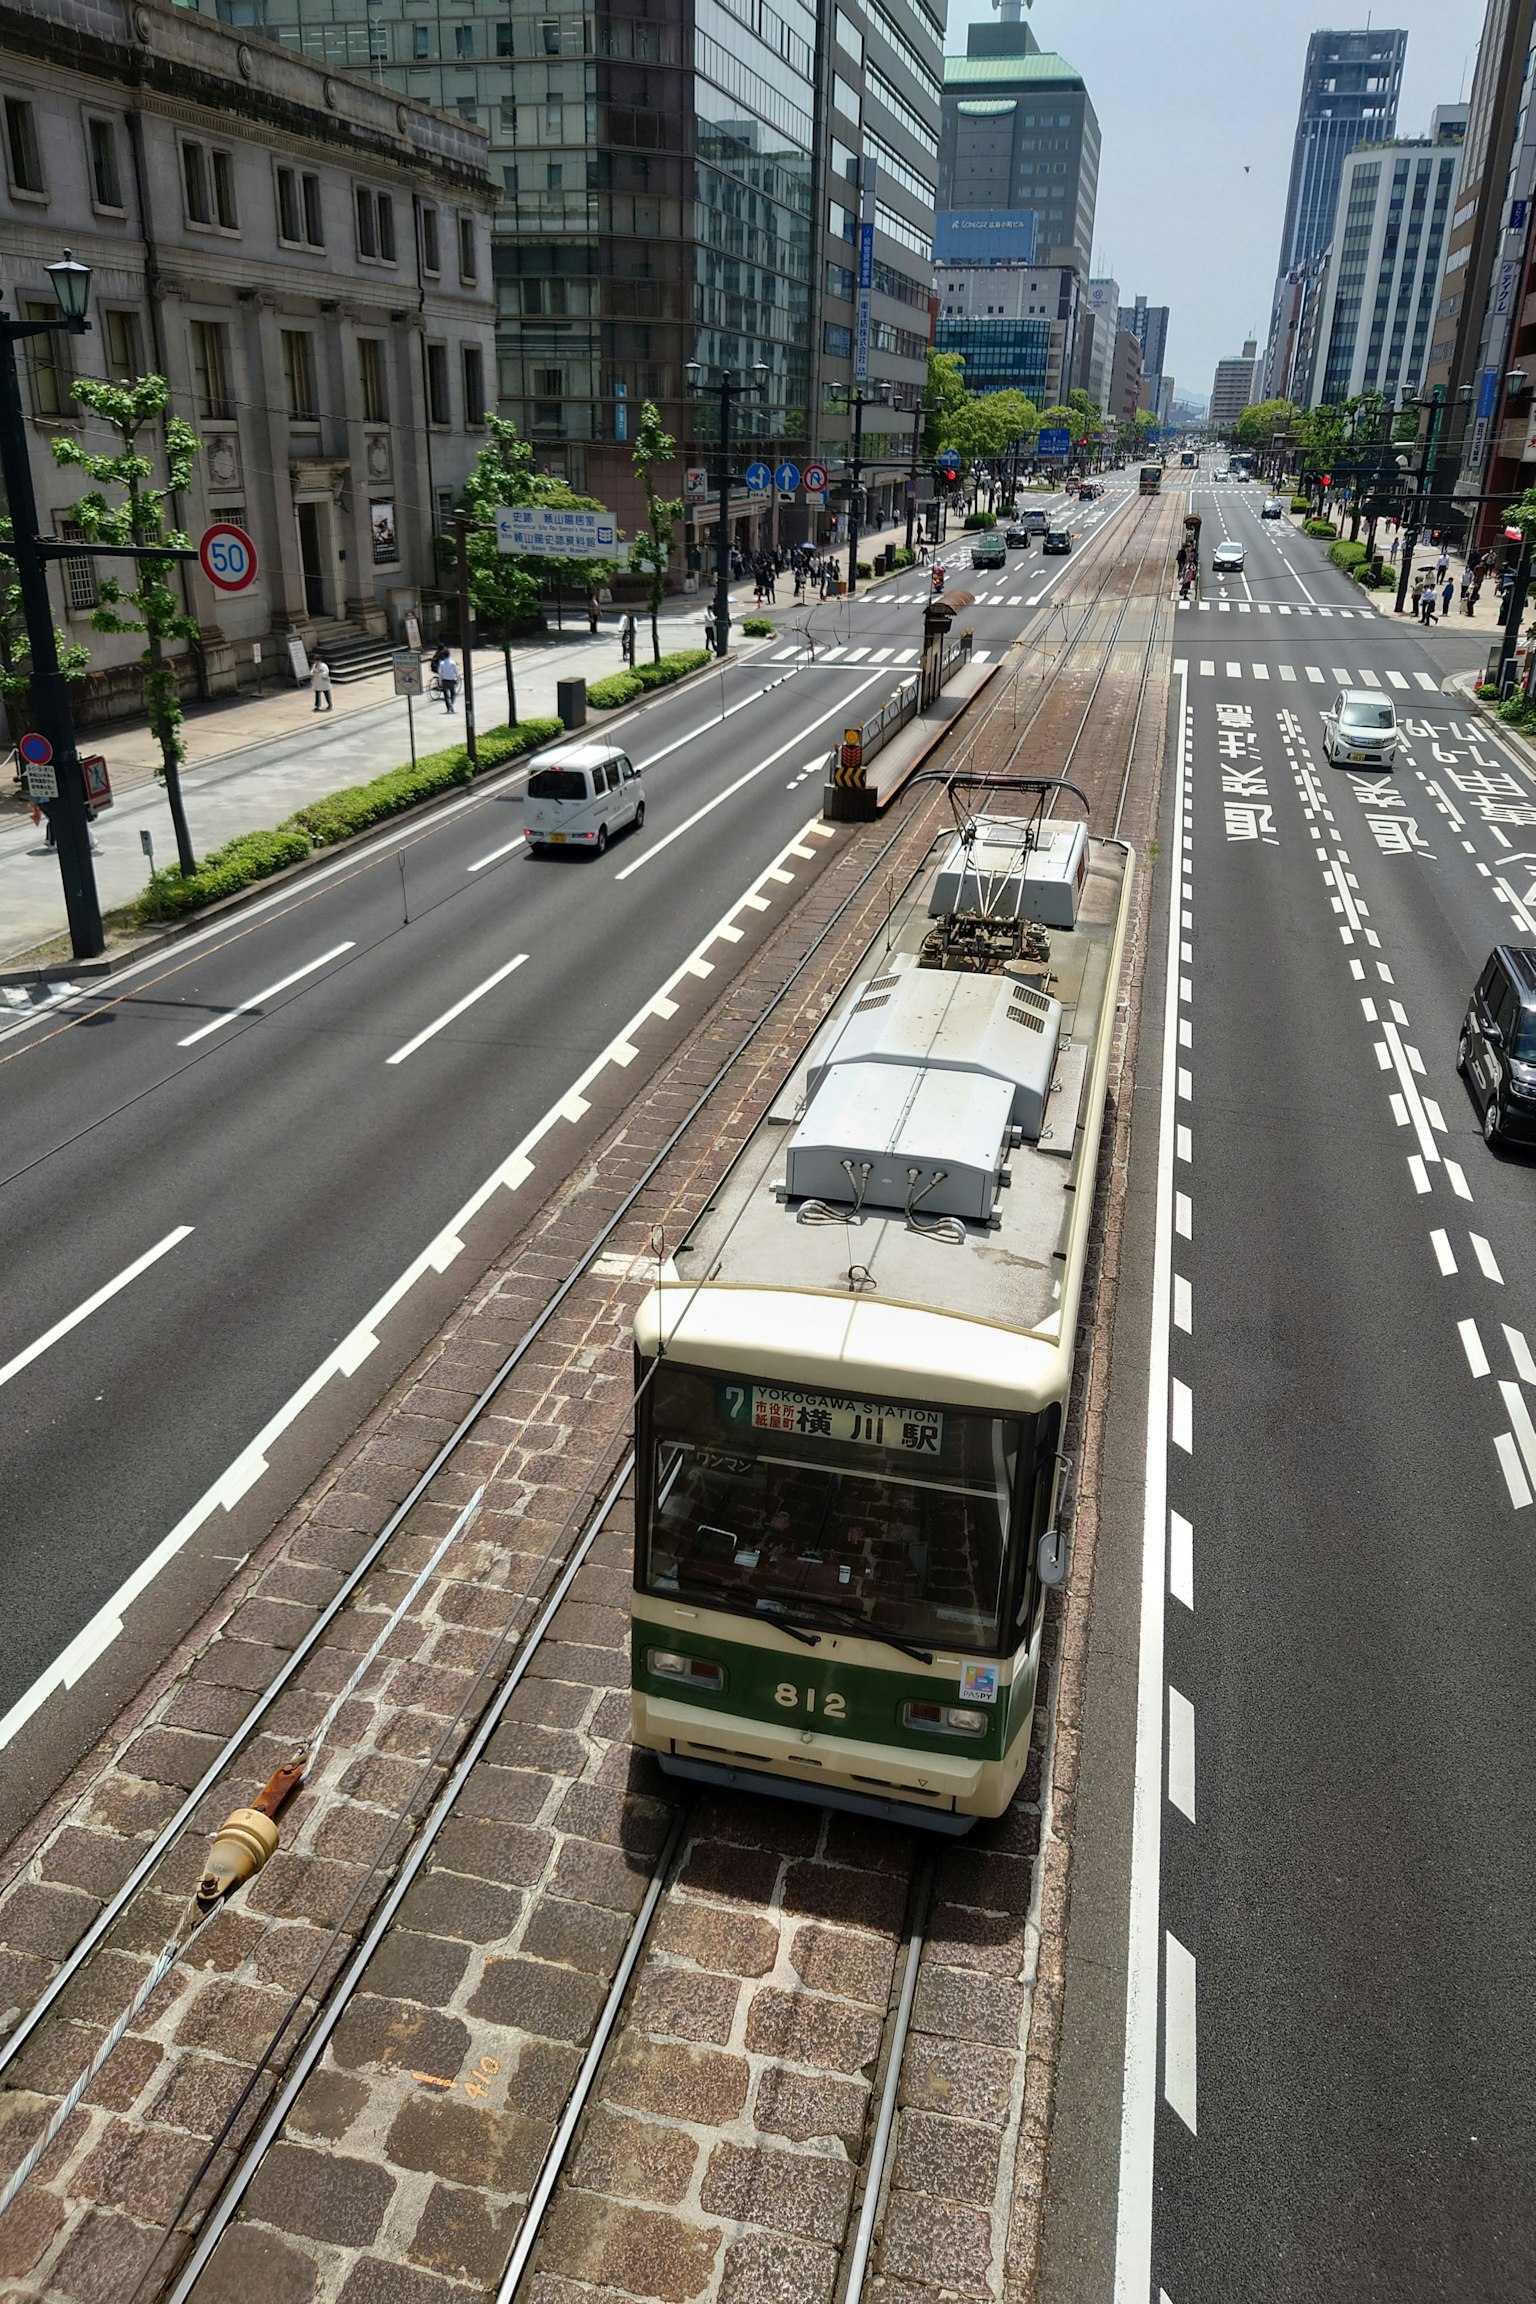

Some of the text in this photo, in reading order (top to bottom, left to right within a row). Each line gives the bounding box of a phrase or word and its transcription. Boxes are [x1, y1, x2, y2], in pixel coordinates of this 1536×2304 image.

[858, 301, 869, 364] 東洋紡株式会社
[513, 512, 532, 523] 史跡
[211, 542, 245, 573] 50
[1215, 703, 1280, 846] 追突注意
[725, 1386, 745, 1418] 7
[755, 1401, 795, 1417] 市役所
[757, 1387, 938, 1424] YOKOGAWA STATION
[755, 1413, 795, 1431] 紙屋町
[796, 1406, 939, 1451] 横川駅
[696, 1452, 752, 1473] ワンマン
[774, 1682, 847, 1719] 812
[963, 1690, 993, 1700] PASPY
